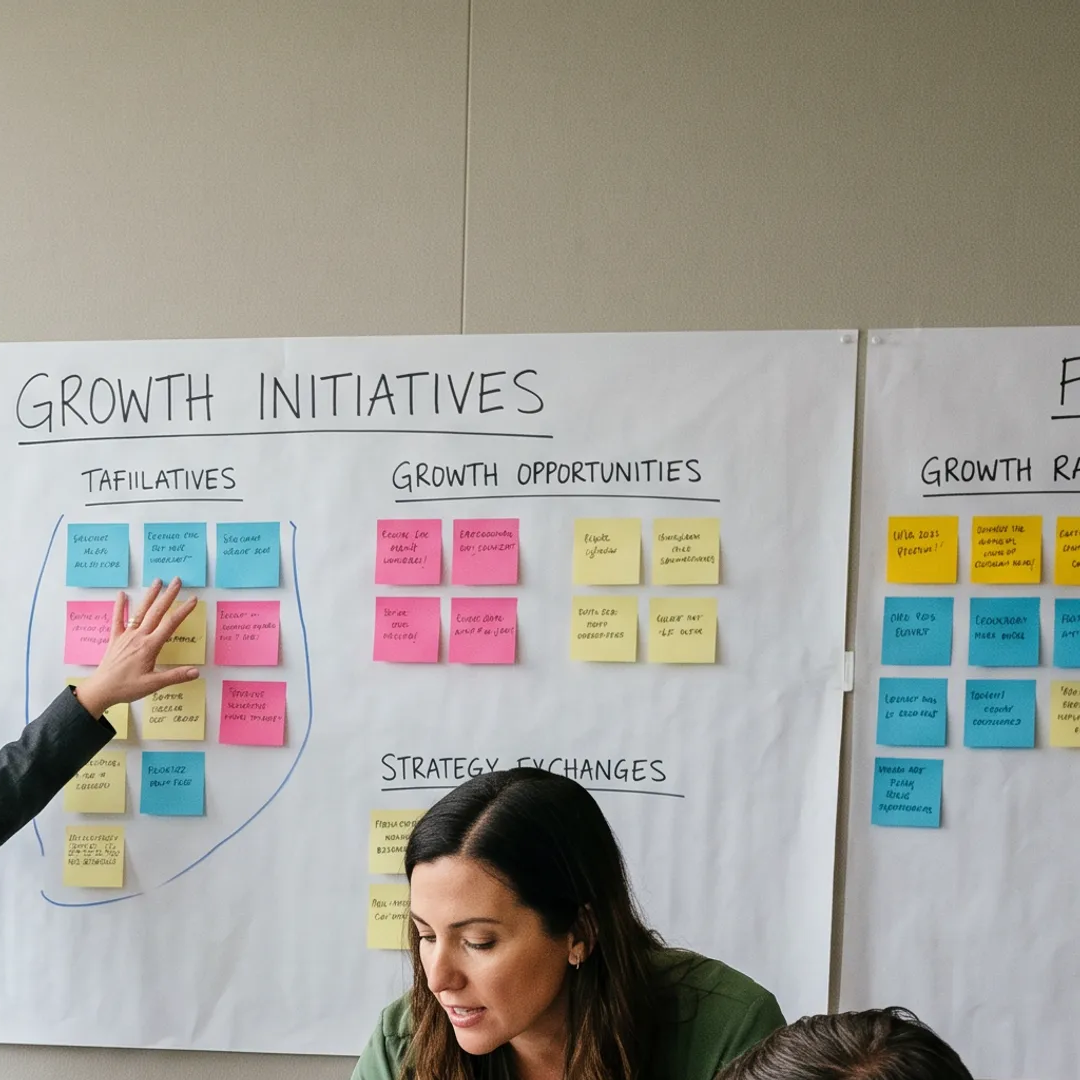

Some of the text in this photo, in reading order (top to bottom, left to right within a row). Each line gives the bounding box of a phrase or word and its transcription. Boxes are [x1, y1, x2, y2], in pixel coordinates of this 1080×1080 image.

[16, 369, 545, 432] GROWTH INITIATIVES
[392, 459, 702, 492] GROWTH OPPORTUNITIES
[921, 456, 1031, 487] GROWTH
[382, 753, 499, 781] STRATEGY
